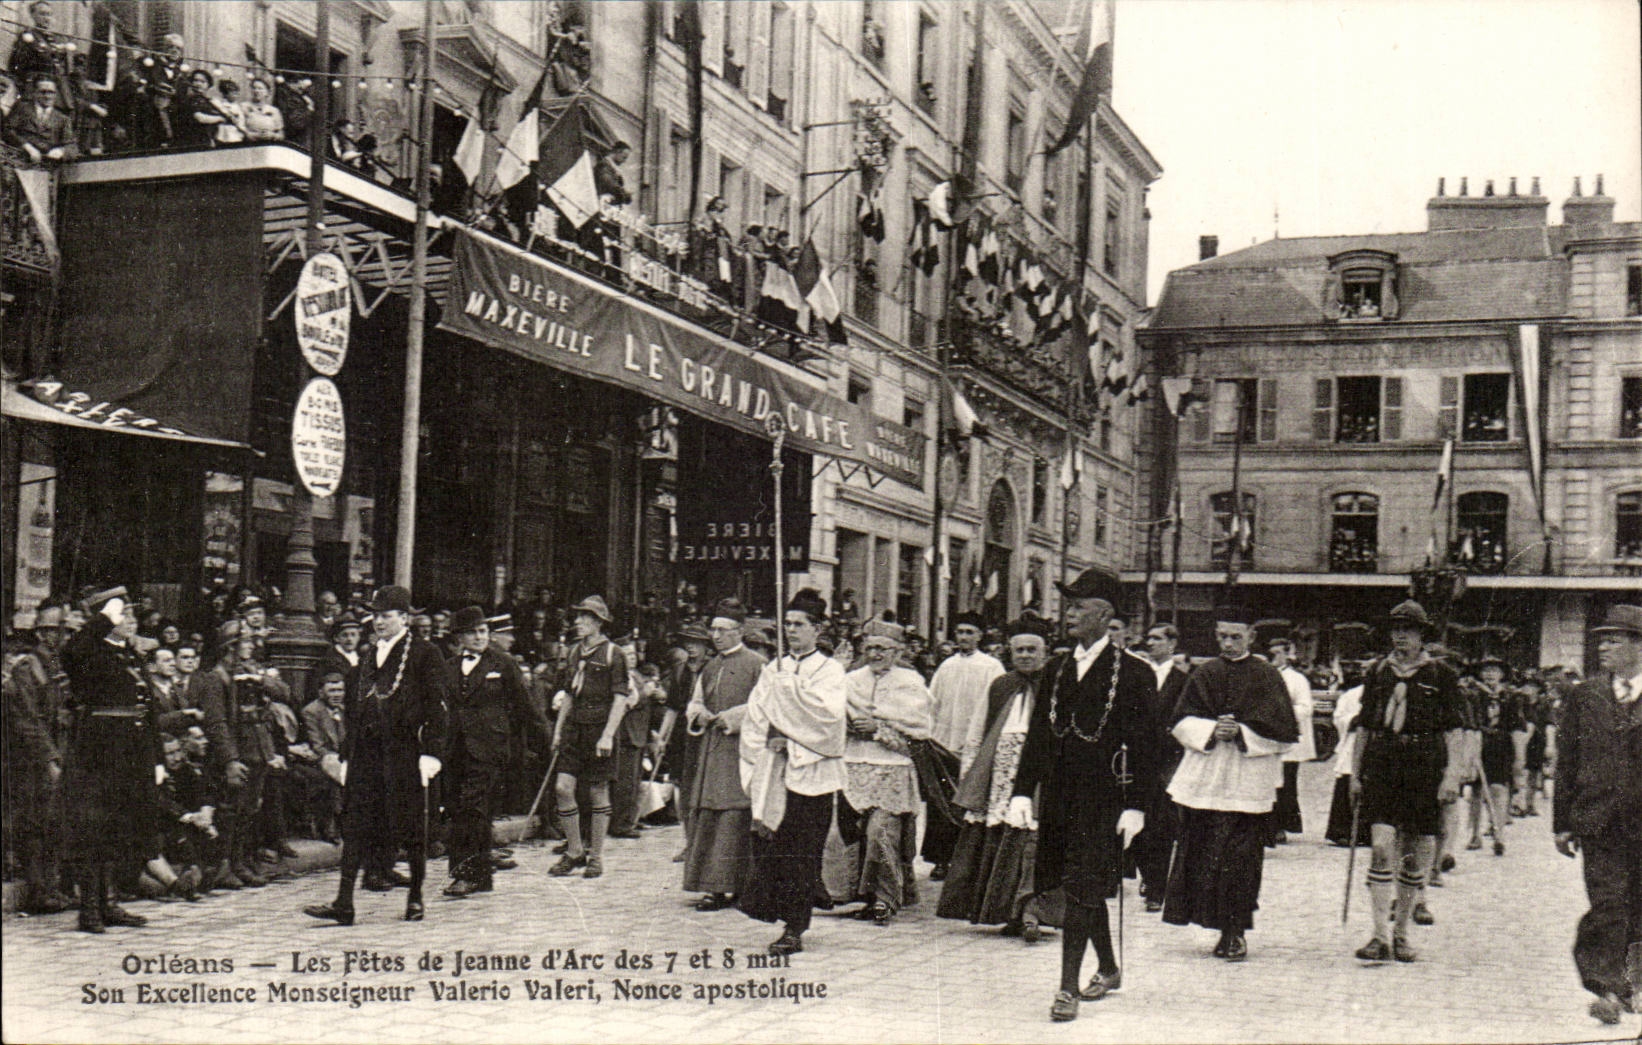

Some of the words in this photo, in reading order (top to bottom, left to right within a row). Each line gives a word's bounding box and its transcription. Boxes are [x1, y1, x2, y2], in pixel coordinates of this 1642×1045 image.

[464, 290, 594, 357] MAXEVILLE
[509, 273, 571, 313] BIERE
[624, 333, 664, 381] LE
[681, 357, 770, 420] GRAND
